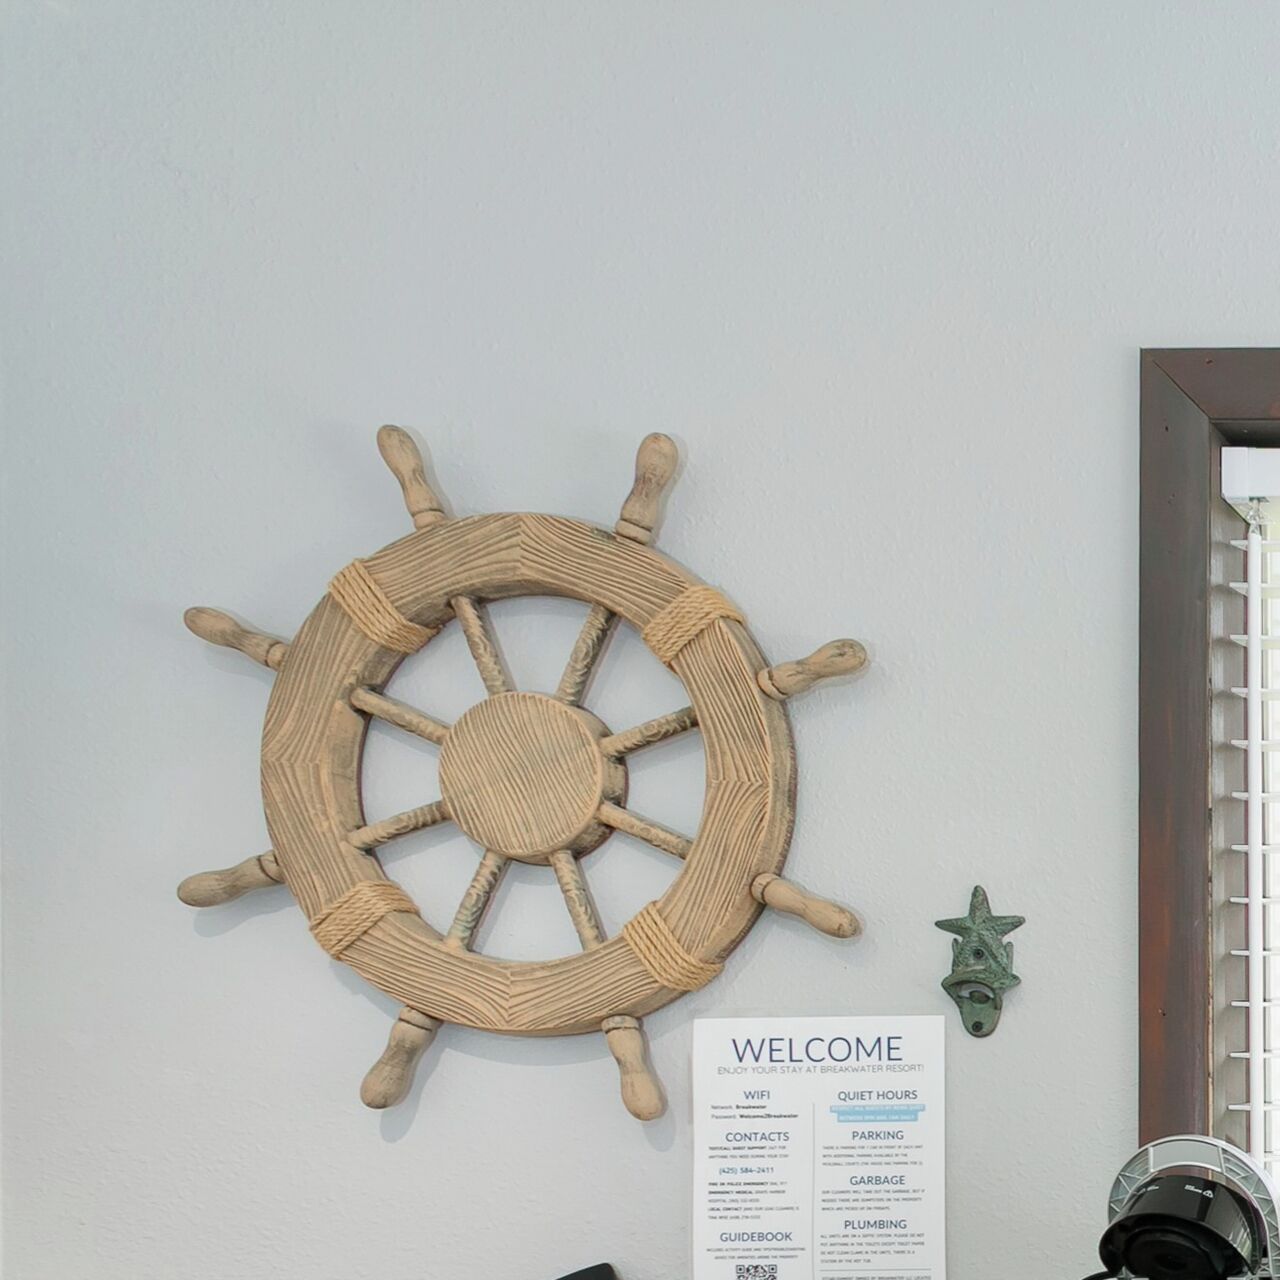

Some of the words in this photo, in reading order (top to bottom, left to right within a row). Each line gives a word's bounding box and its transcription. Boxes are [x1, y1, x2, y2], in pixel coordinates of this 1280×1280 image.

[731, 1036, 904, 1064] WELCOME
[717, 1066, 748, 1075] ENJOY
[750, 1065, 779, 1075] YOUR
[780, 1065, 804, 1074] STAY
[805, 1065, 817, 1074] AT
[819, 1064, 884, 1074] BREAKWATER
[743, 1090, 771, 1100] WIFI
[837, 1090, 873, 1103] QUIET
[876, 1089, 918, 1100] HOURS
[725, 1131, 790, 1142] CONTACTS
[851, 1130, 905, 1141] PARKING
[849, 1175, 906, 1186] GARBAGE
[844, 1219, 908, 1230] PLUMBING
[719, 1231, 793, 1243] GUIDEBOOK
